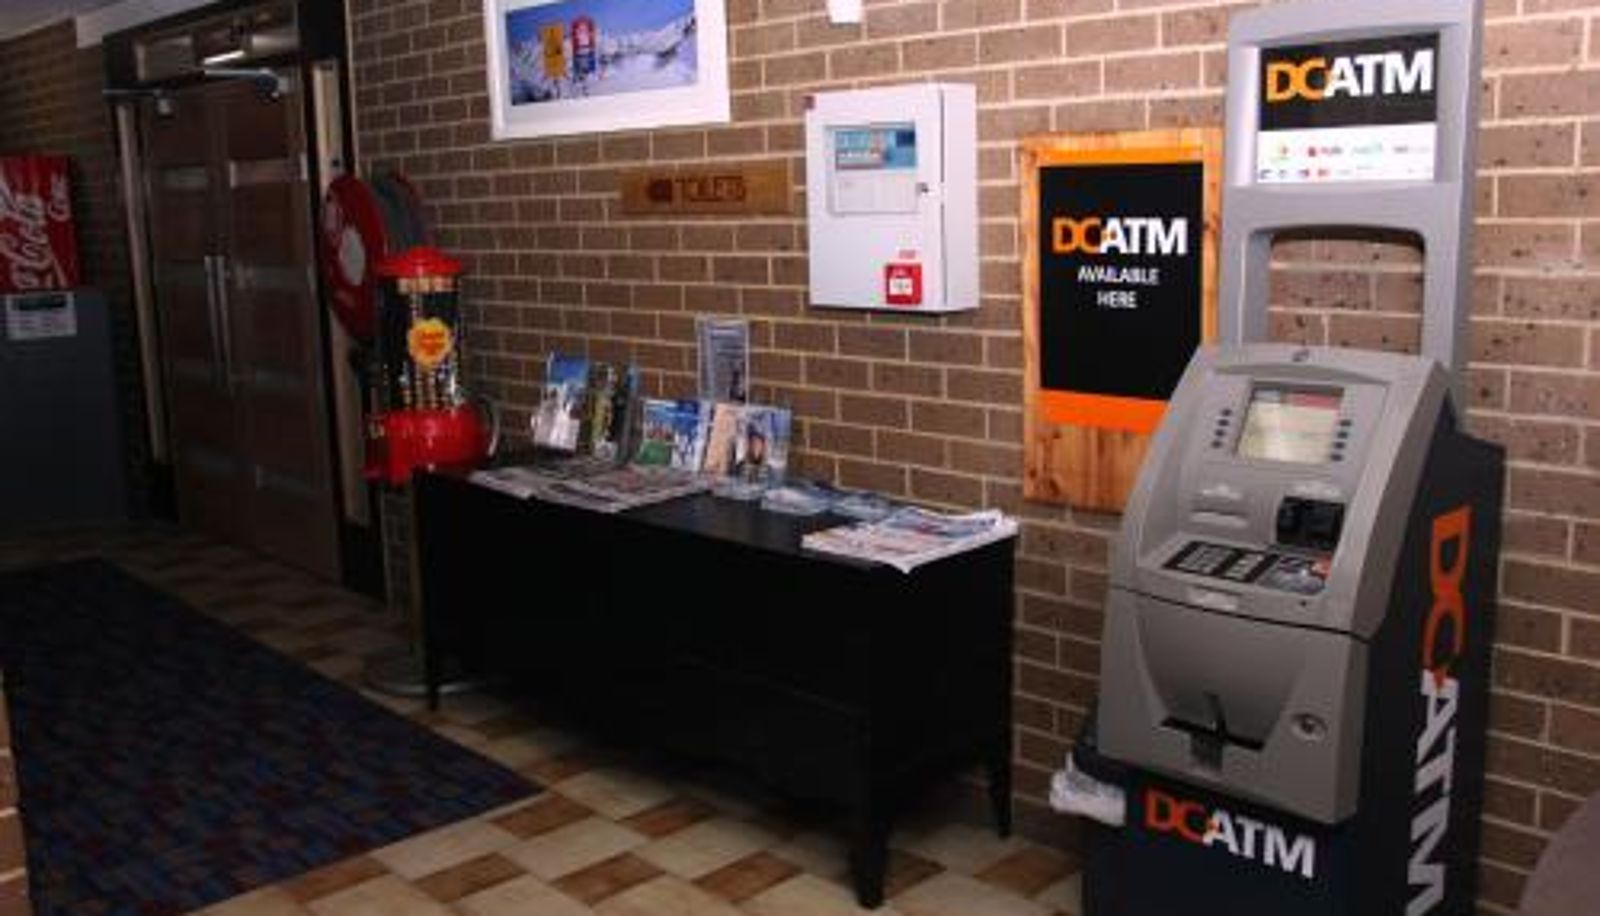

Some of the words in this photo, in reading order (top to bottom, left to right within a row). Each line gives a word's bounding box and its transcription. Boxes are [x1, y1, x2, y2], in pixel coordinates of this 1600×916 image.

[1265, 49, 1435, 103] DCATM
[1051, 216, 1189, 255] DCATM
[1076, 265, 1161, 286] AVAILABLE
[1096, 290, 1138, 309] HERE
[1405, 505, 1471, 916] DCATM
[1145, 789, 1316, 878] DCATM
